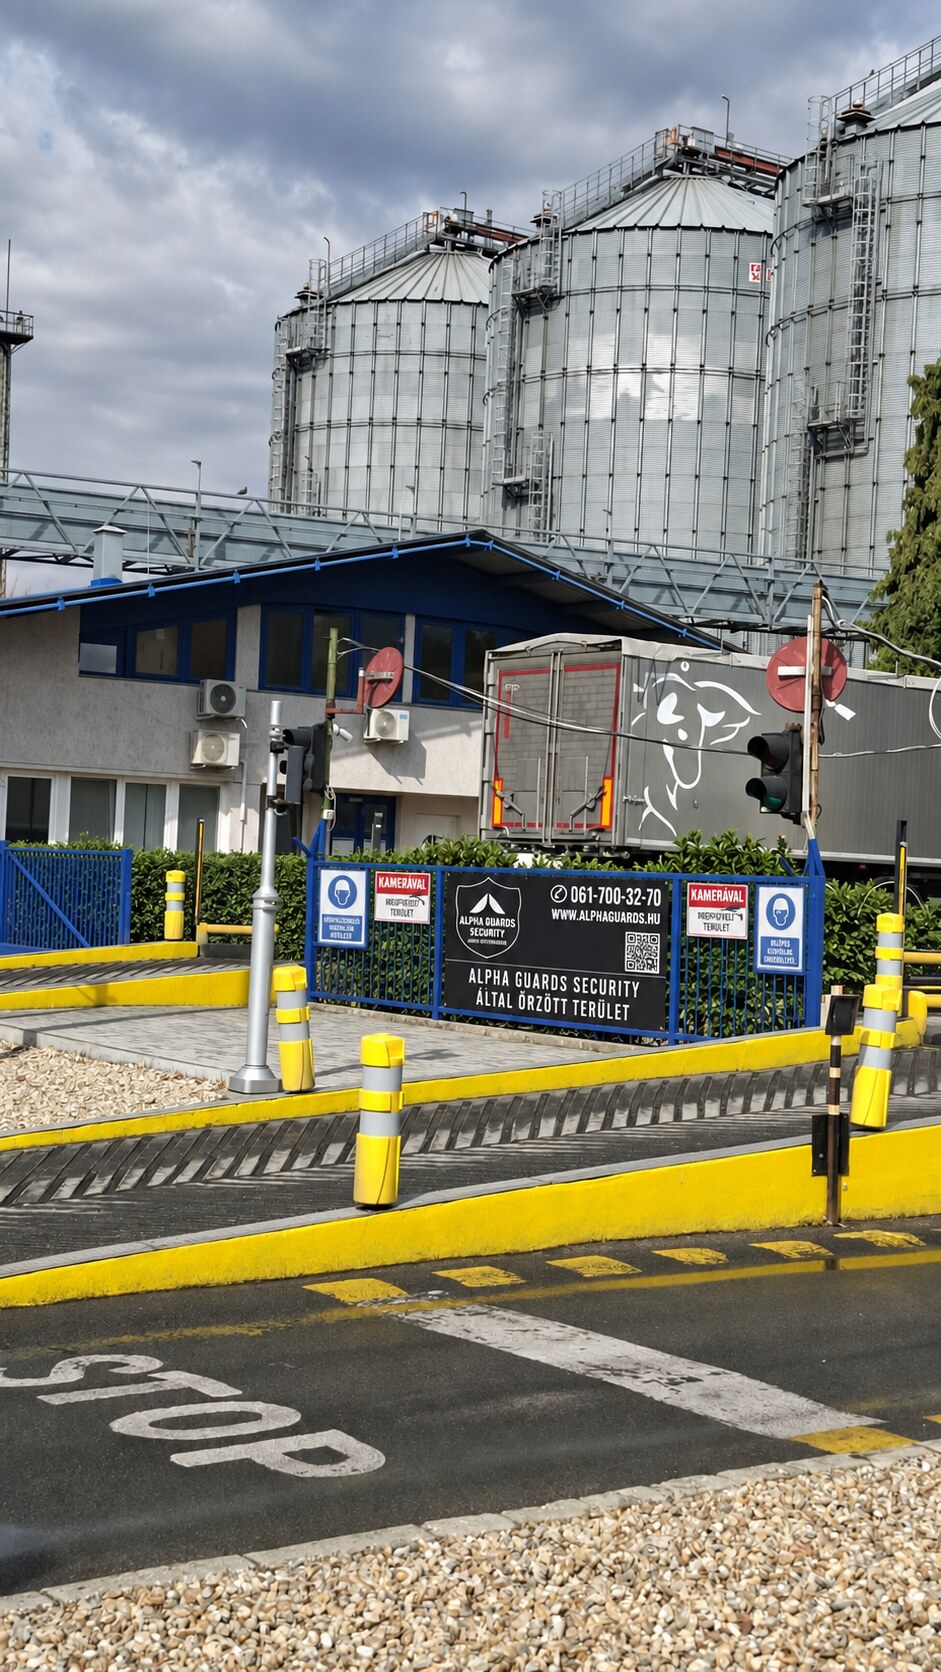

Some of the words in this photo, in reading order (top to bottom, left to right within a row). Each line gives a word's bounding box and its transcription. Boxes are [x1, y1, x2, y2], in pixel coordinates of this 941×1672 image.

[378, 875, 427, 890] KAMERÁVAL
[570, 885, 662, 907] 061-700-32-70
[691, 887, 744, 902] KAMERÁVAL
[459, 916, 484, 926] ALPHA
[485, 917, 516, 928] GUARDS
[551, 908, 661, 925] WWW.ALPHAGUARDS.HU
[470, 927, 505, 938] SECURITY
[468, 968, 510, 987] ALPHA
[515, 971, 567, 992] GUARDS
[573, 976, 640, 998] SECURITY
[476, 987, 513, 1009] ÁLTAL
[572, 998, 630, 1021] TERÜLET
[0, 1354, 386, 1477] STOP
